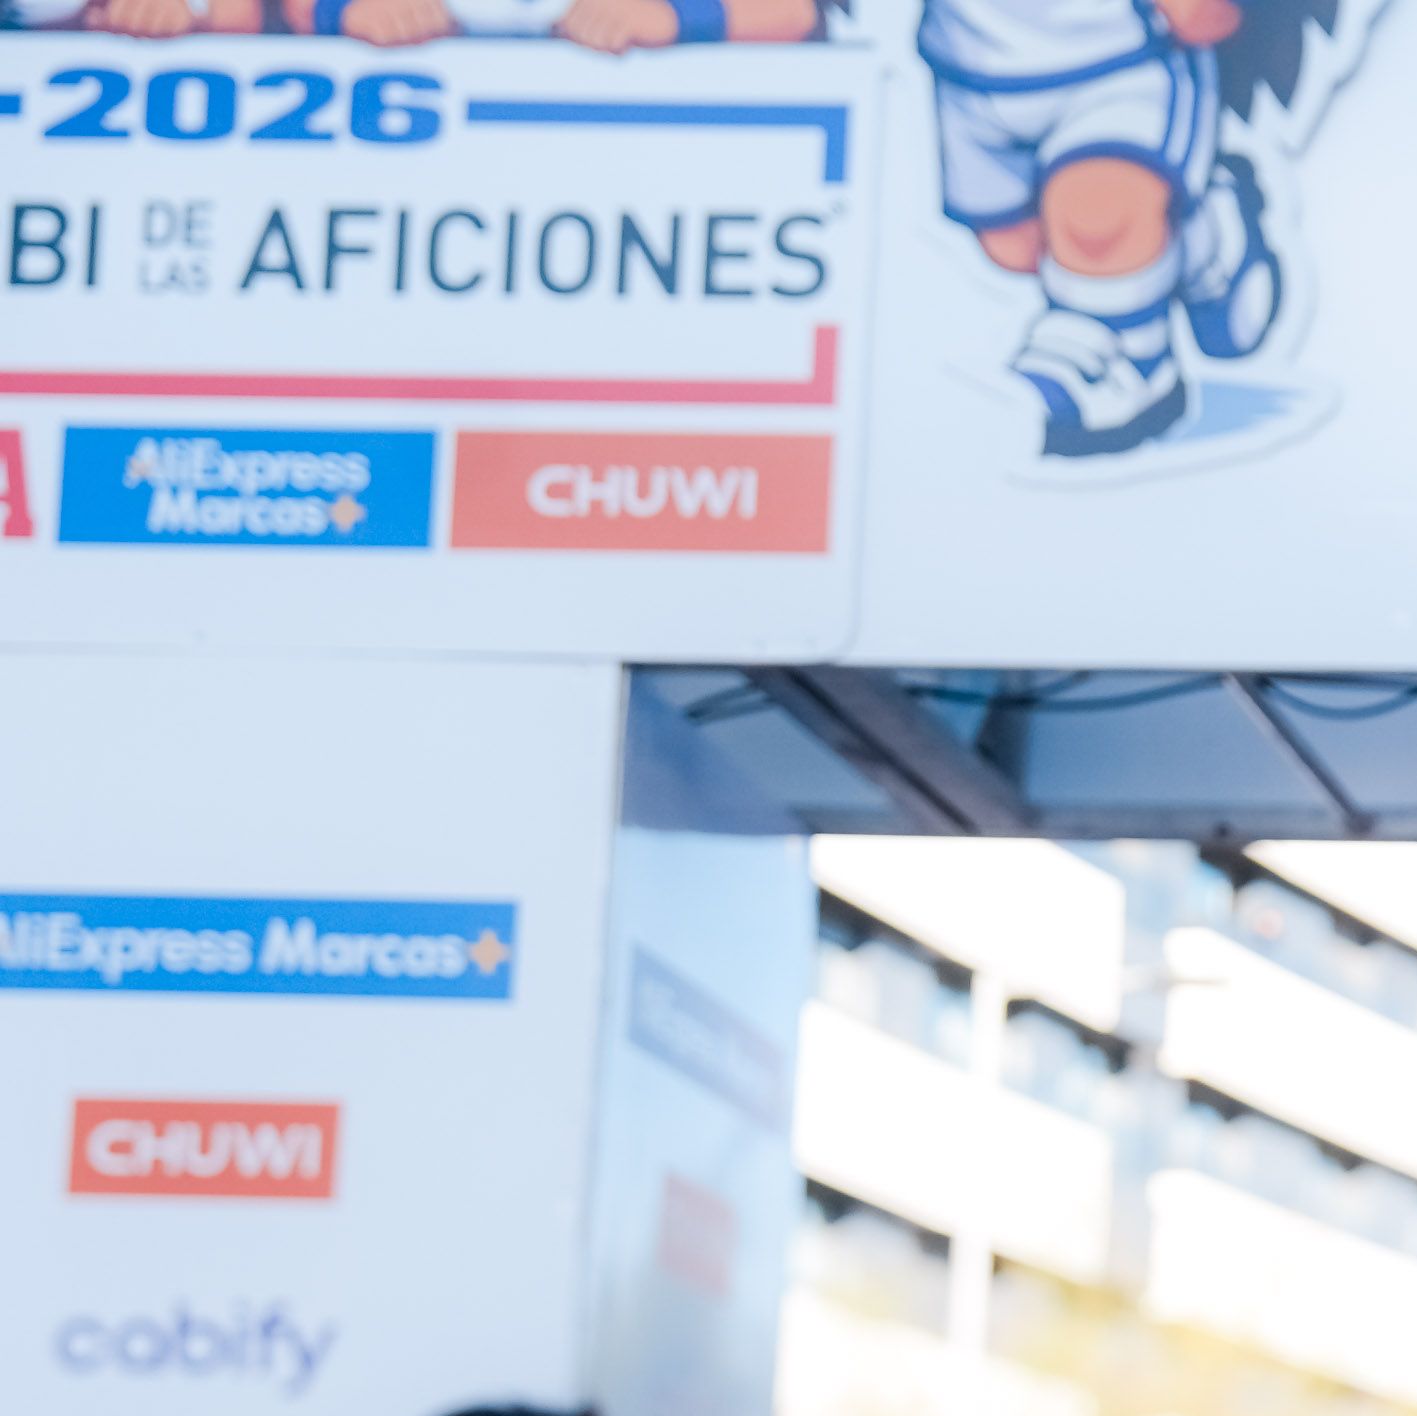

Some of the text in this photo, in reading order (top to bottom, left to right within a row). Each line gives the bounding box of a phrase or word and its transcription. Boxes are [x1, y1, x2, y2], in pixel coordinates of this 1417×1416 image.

[43, 66, 447, 146] 2026
[239, 205, 828, 299] AFICIONES
[527, 464, 758, 520] CHUWI
[86, 1118, 324, 1180] CHUWI
[54, 1301, 340, 1397] cabify
